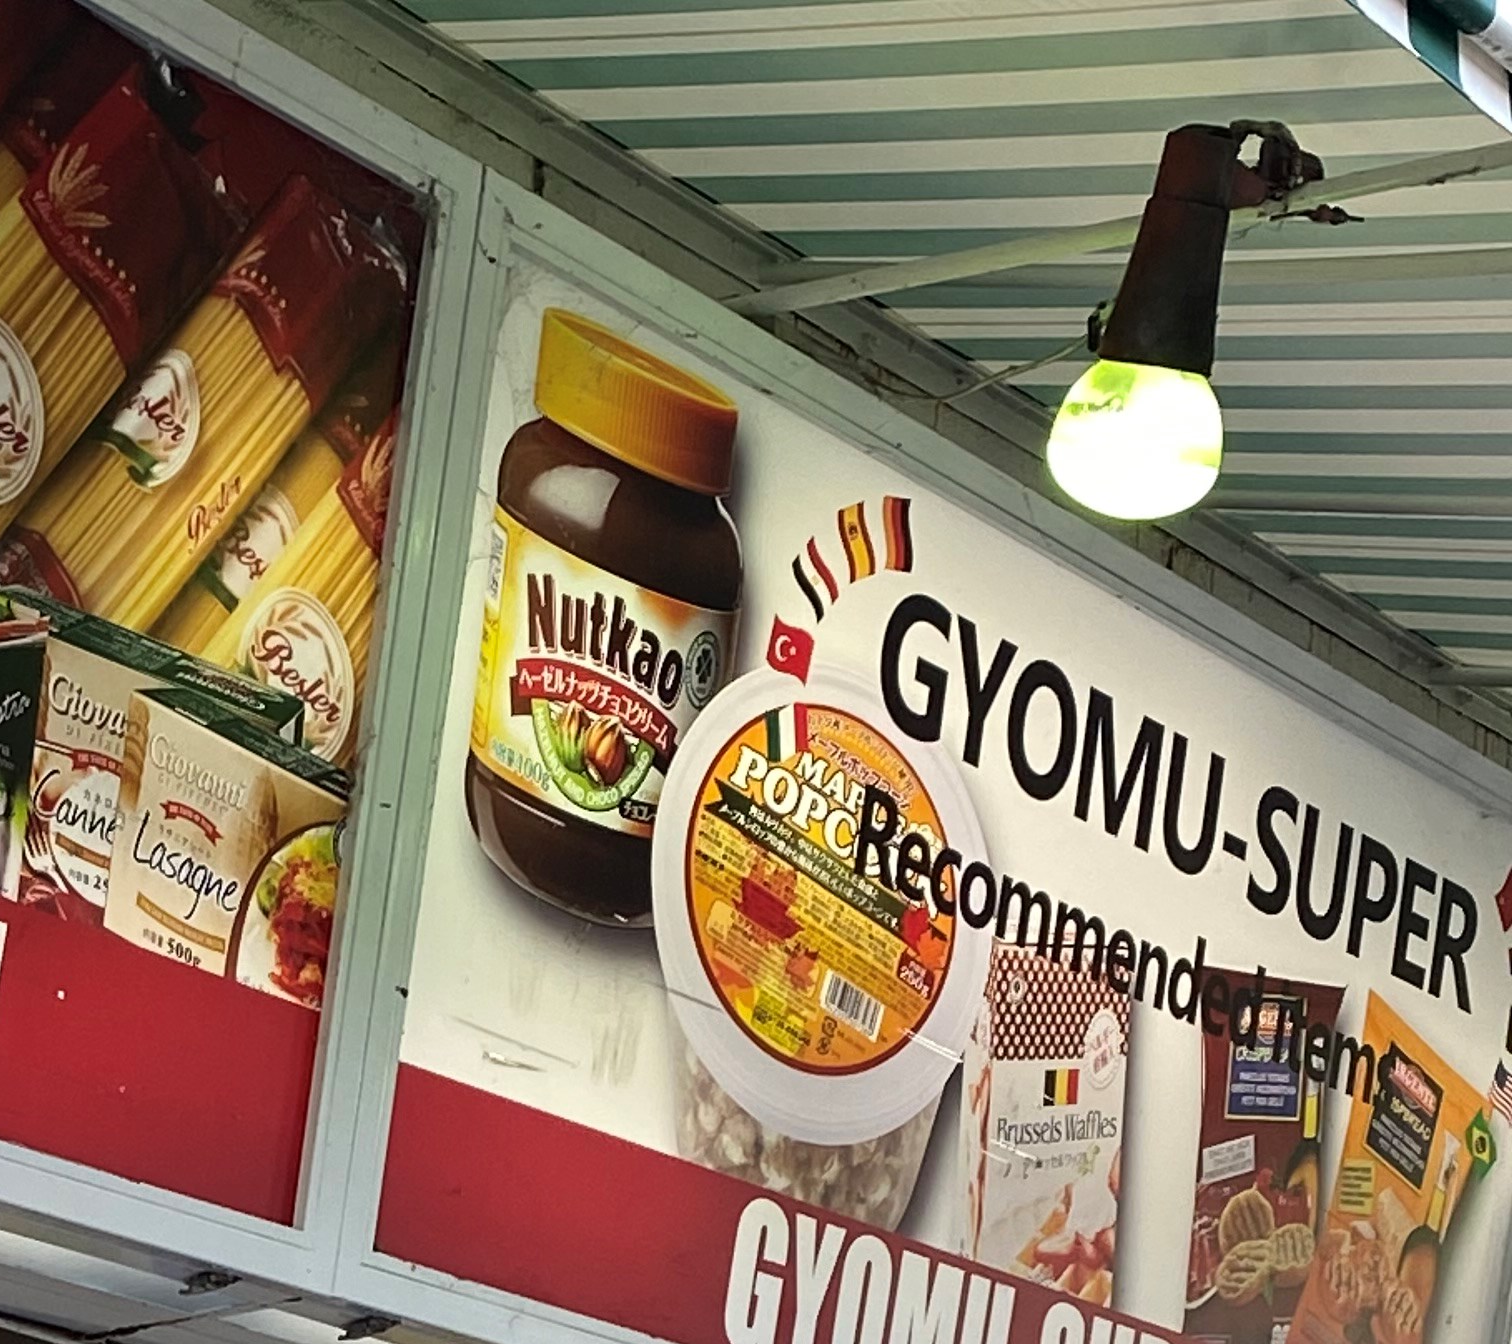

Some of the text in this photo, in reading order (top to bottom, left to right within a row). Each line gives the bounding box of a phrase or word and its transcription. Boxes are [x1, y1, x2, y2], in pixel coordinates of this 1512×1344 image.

[250, 628, 342, 725] Besler
[527, 573, 684, 710] Nutkao
[49, 674, 129, 739] Giova
[518, 667, 669, 751] ヘーゼルナッツチョコクリーム
[879, 593, 1479, 1015] GYOMU-SUPER
[133, 809, 239, 920] Lasagne
[853, 783, 1266, 1049] Recommended
[996, 1109, 1119, 1146] Brussels Waffles
